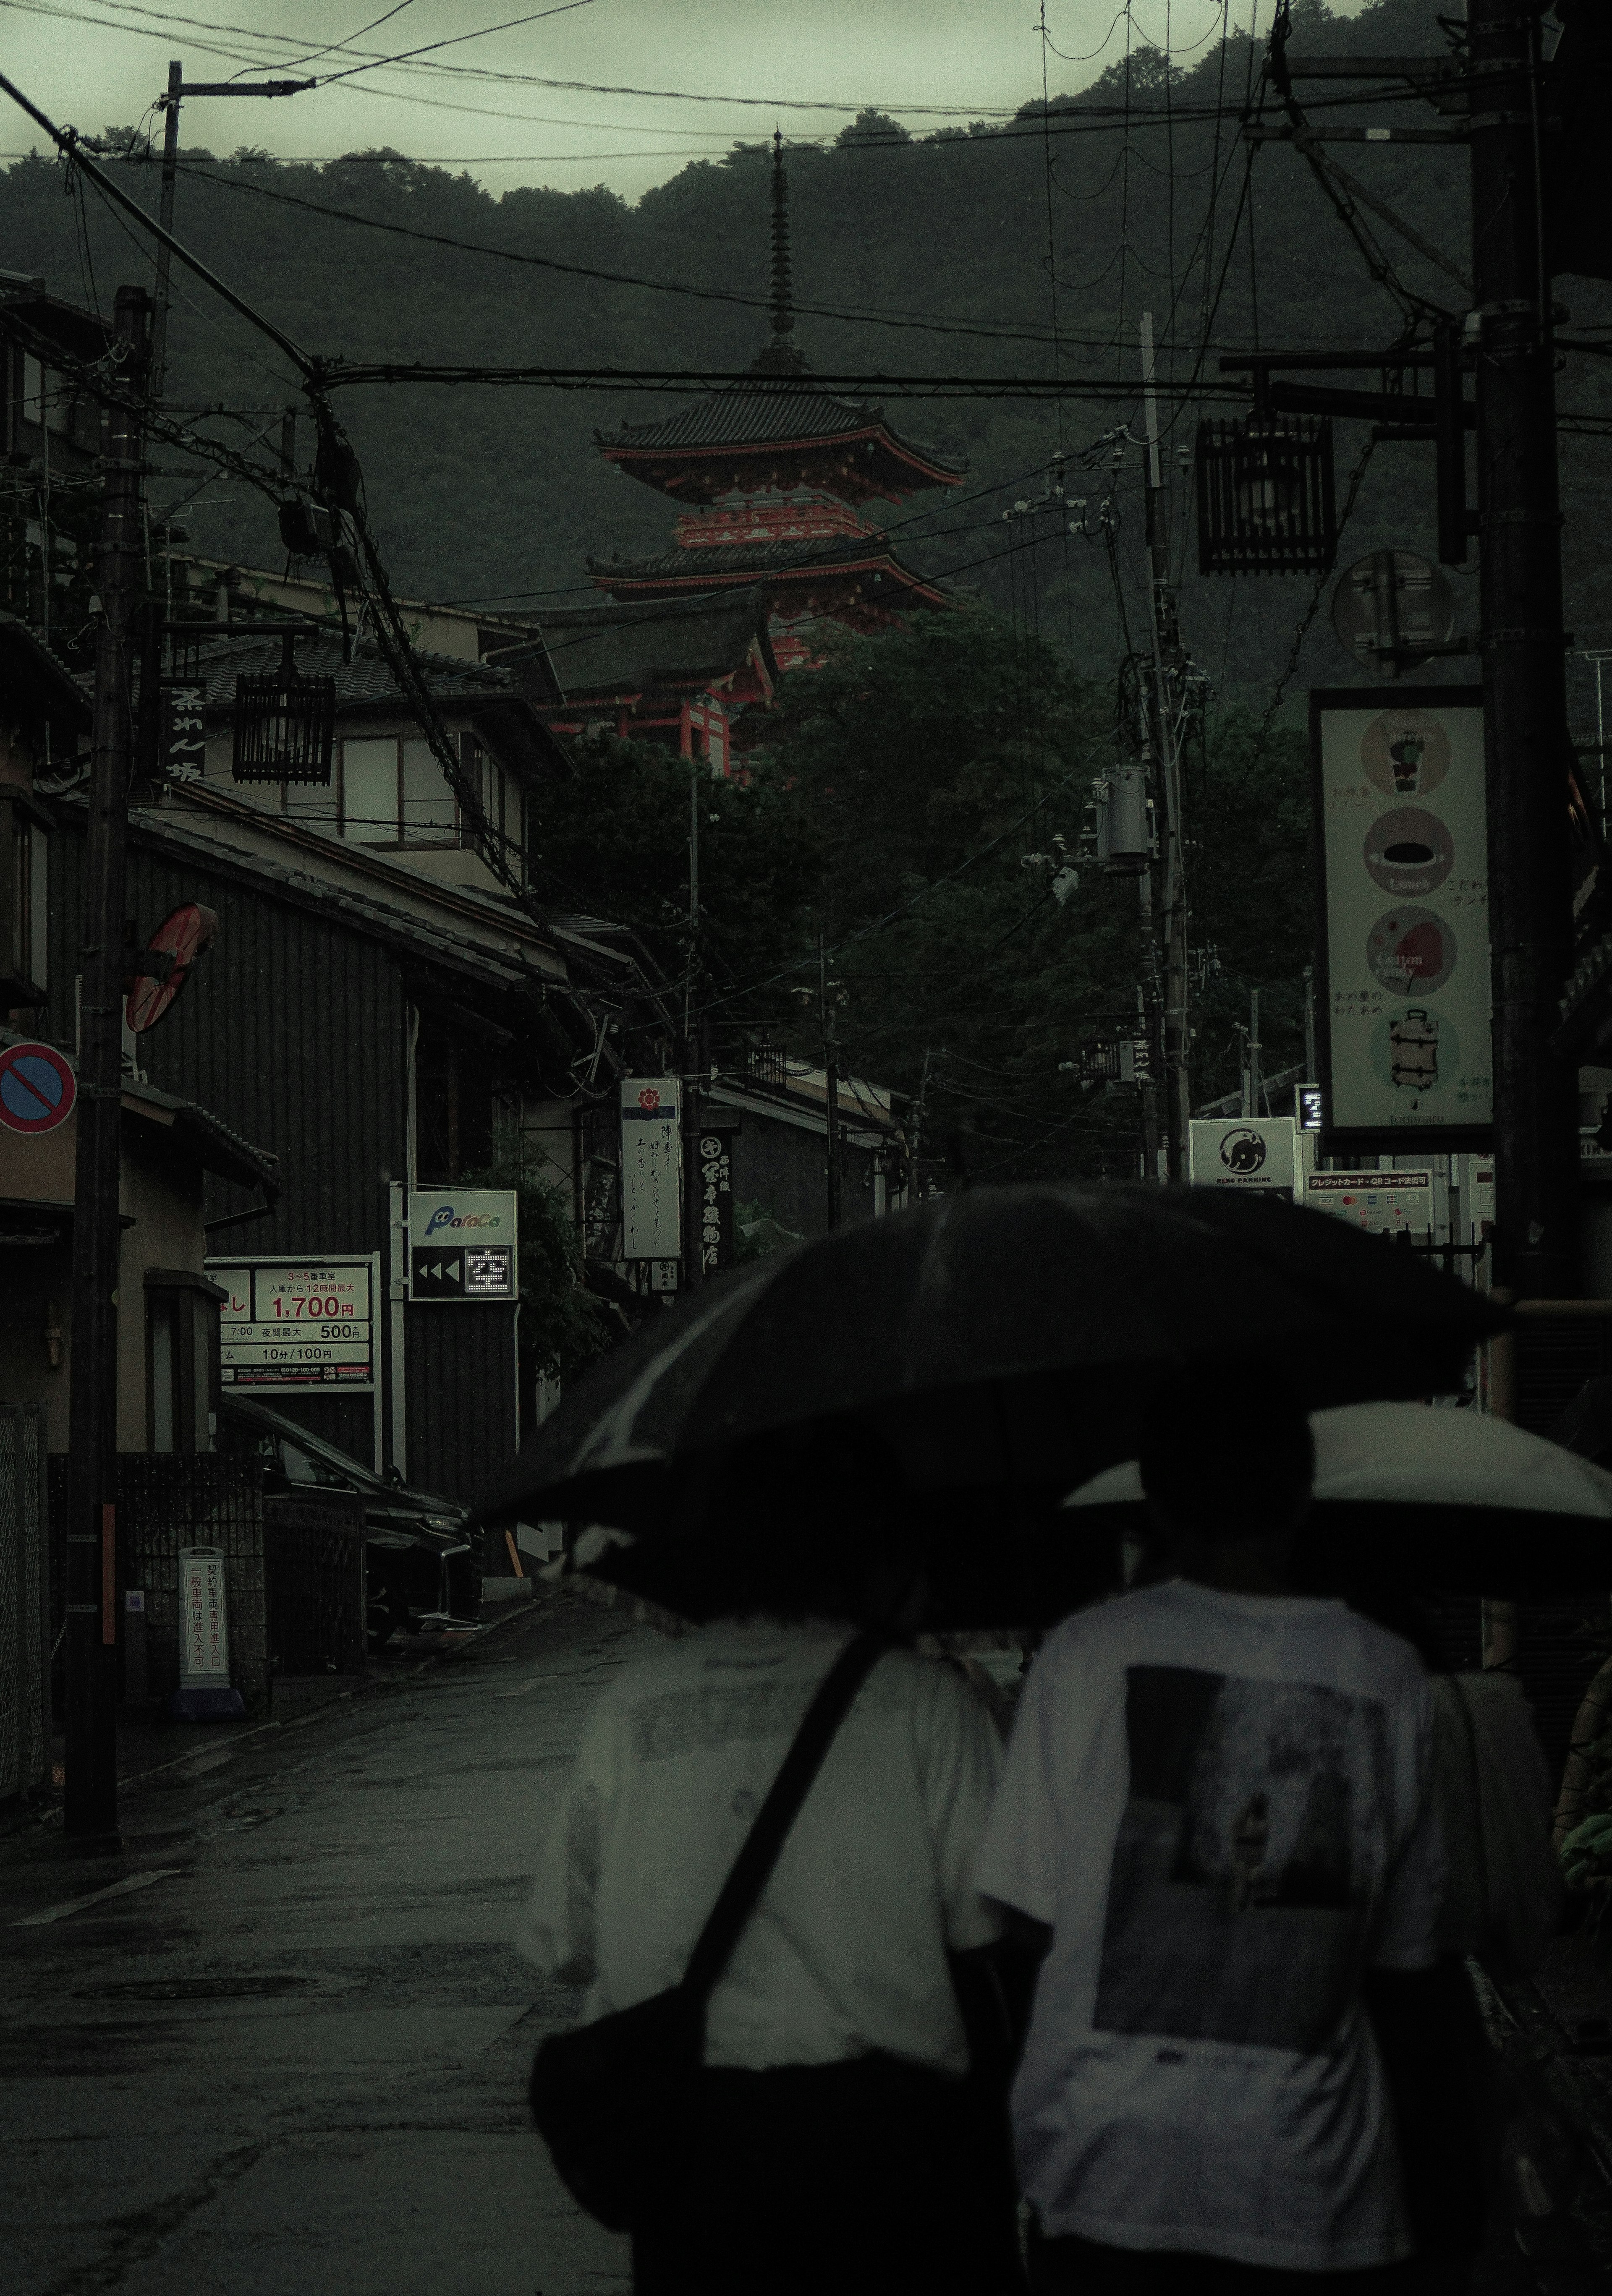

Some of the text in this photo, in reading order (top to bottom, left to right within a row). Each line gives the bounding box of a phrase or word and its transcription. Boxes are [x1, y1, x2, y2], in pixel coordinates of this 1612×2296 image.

[468, 1250, 508, 1290] 空
[307, 1284, 354, 1293] 12時間最大
[273, 1296, 353, 1317] 1,700円
[231, 1327, 253, 1336] 7:00
[262, 1328, 301, 1337] 夜間最大
[263, 1348, 332, 1360] 10分/100円
[191, 1568, 204, 1667] 一般車両は進入不可
[207, 1565, 220, 1667] 契約車両専用進入口
